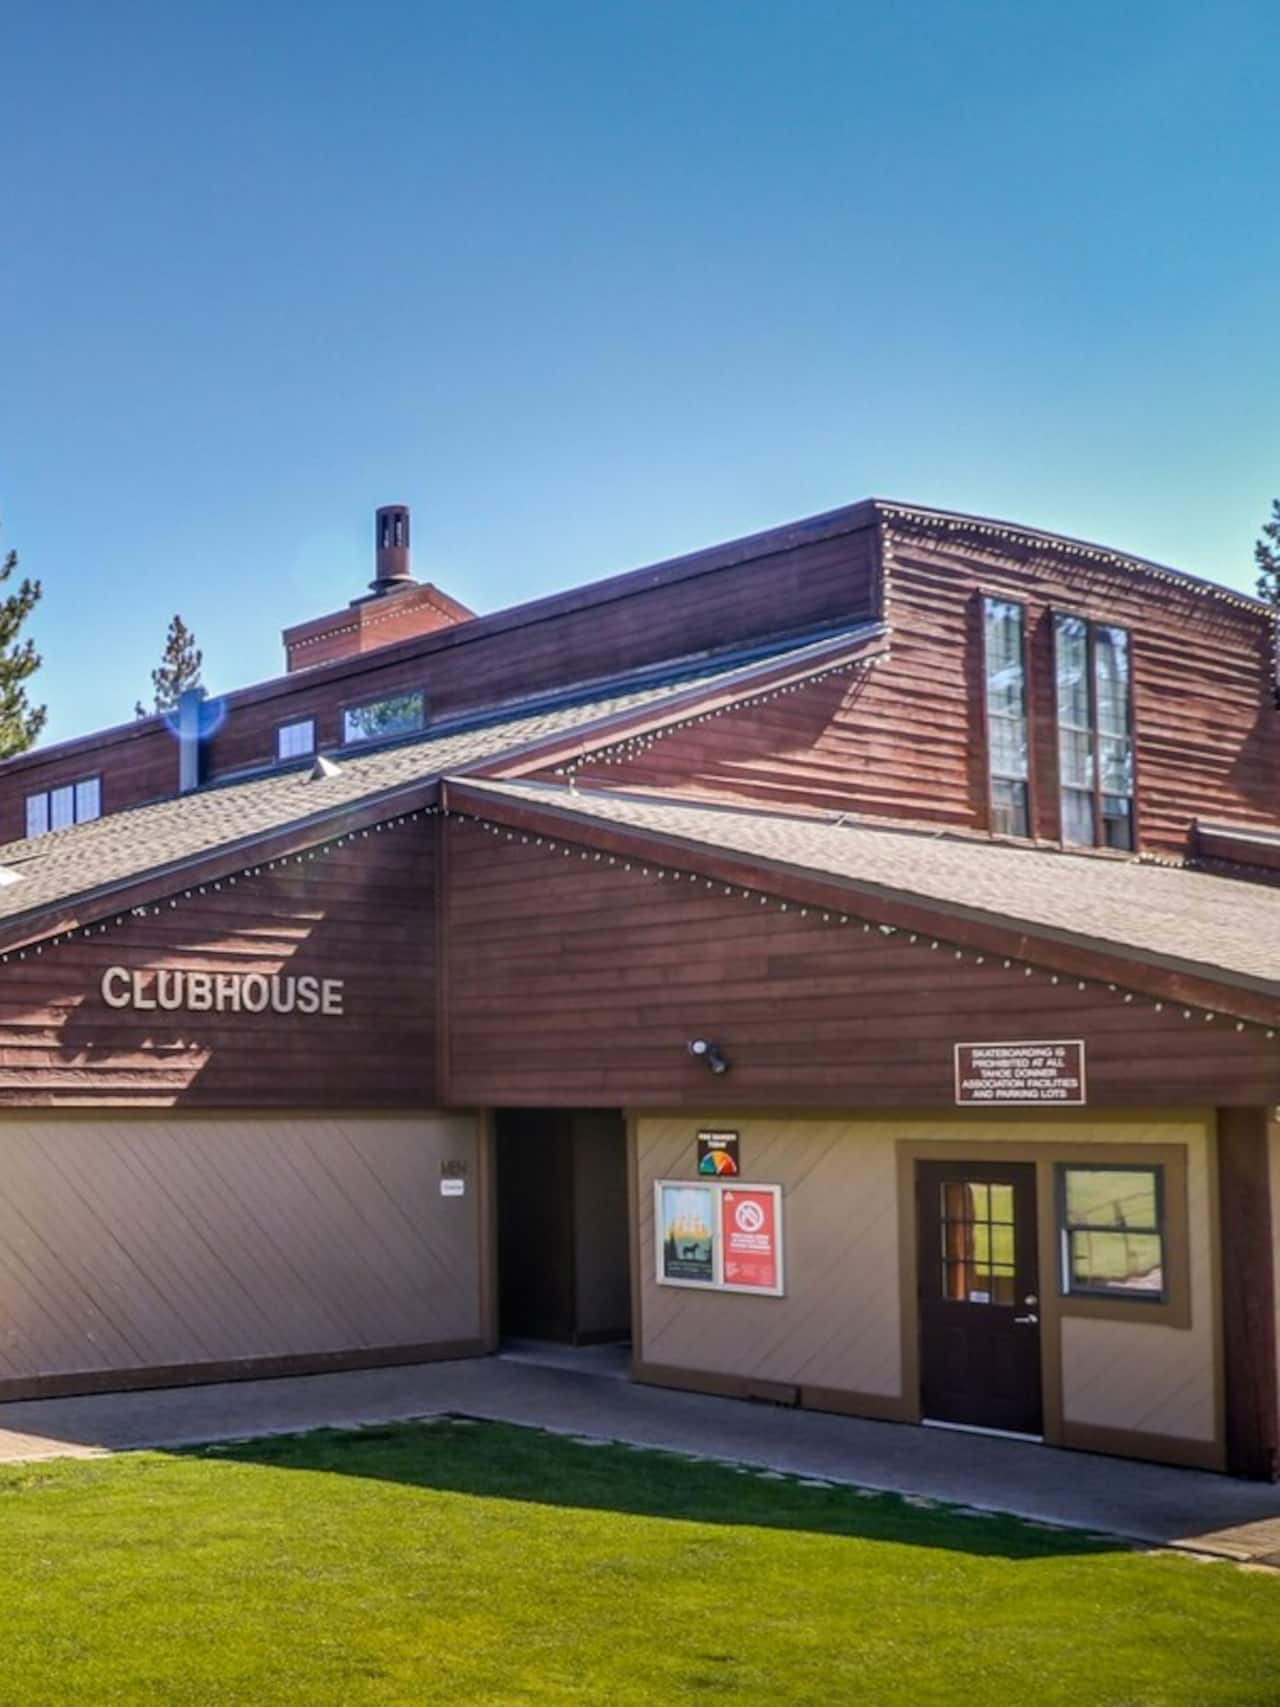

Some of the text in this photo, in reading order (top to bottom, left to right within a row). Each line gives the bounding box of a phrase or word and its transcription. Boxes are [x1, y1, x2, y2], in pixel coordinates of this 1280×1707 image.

[101, 966, 344, 1015] CLUBHOUSE
[972, 1047, 1066, 1058] SKATEBOARDING IS
[972, 1058, 1065, 1068] PROHIBITED AT ALL
[981, 1068, 1058, 1078] TAHOE DONNER
[962, 1078, 1078, 1089] ASSOCIATION FACILITIES
[972, 1089, 1067, 1099] AND PARKING LOTS
